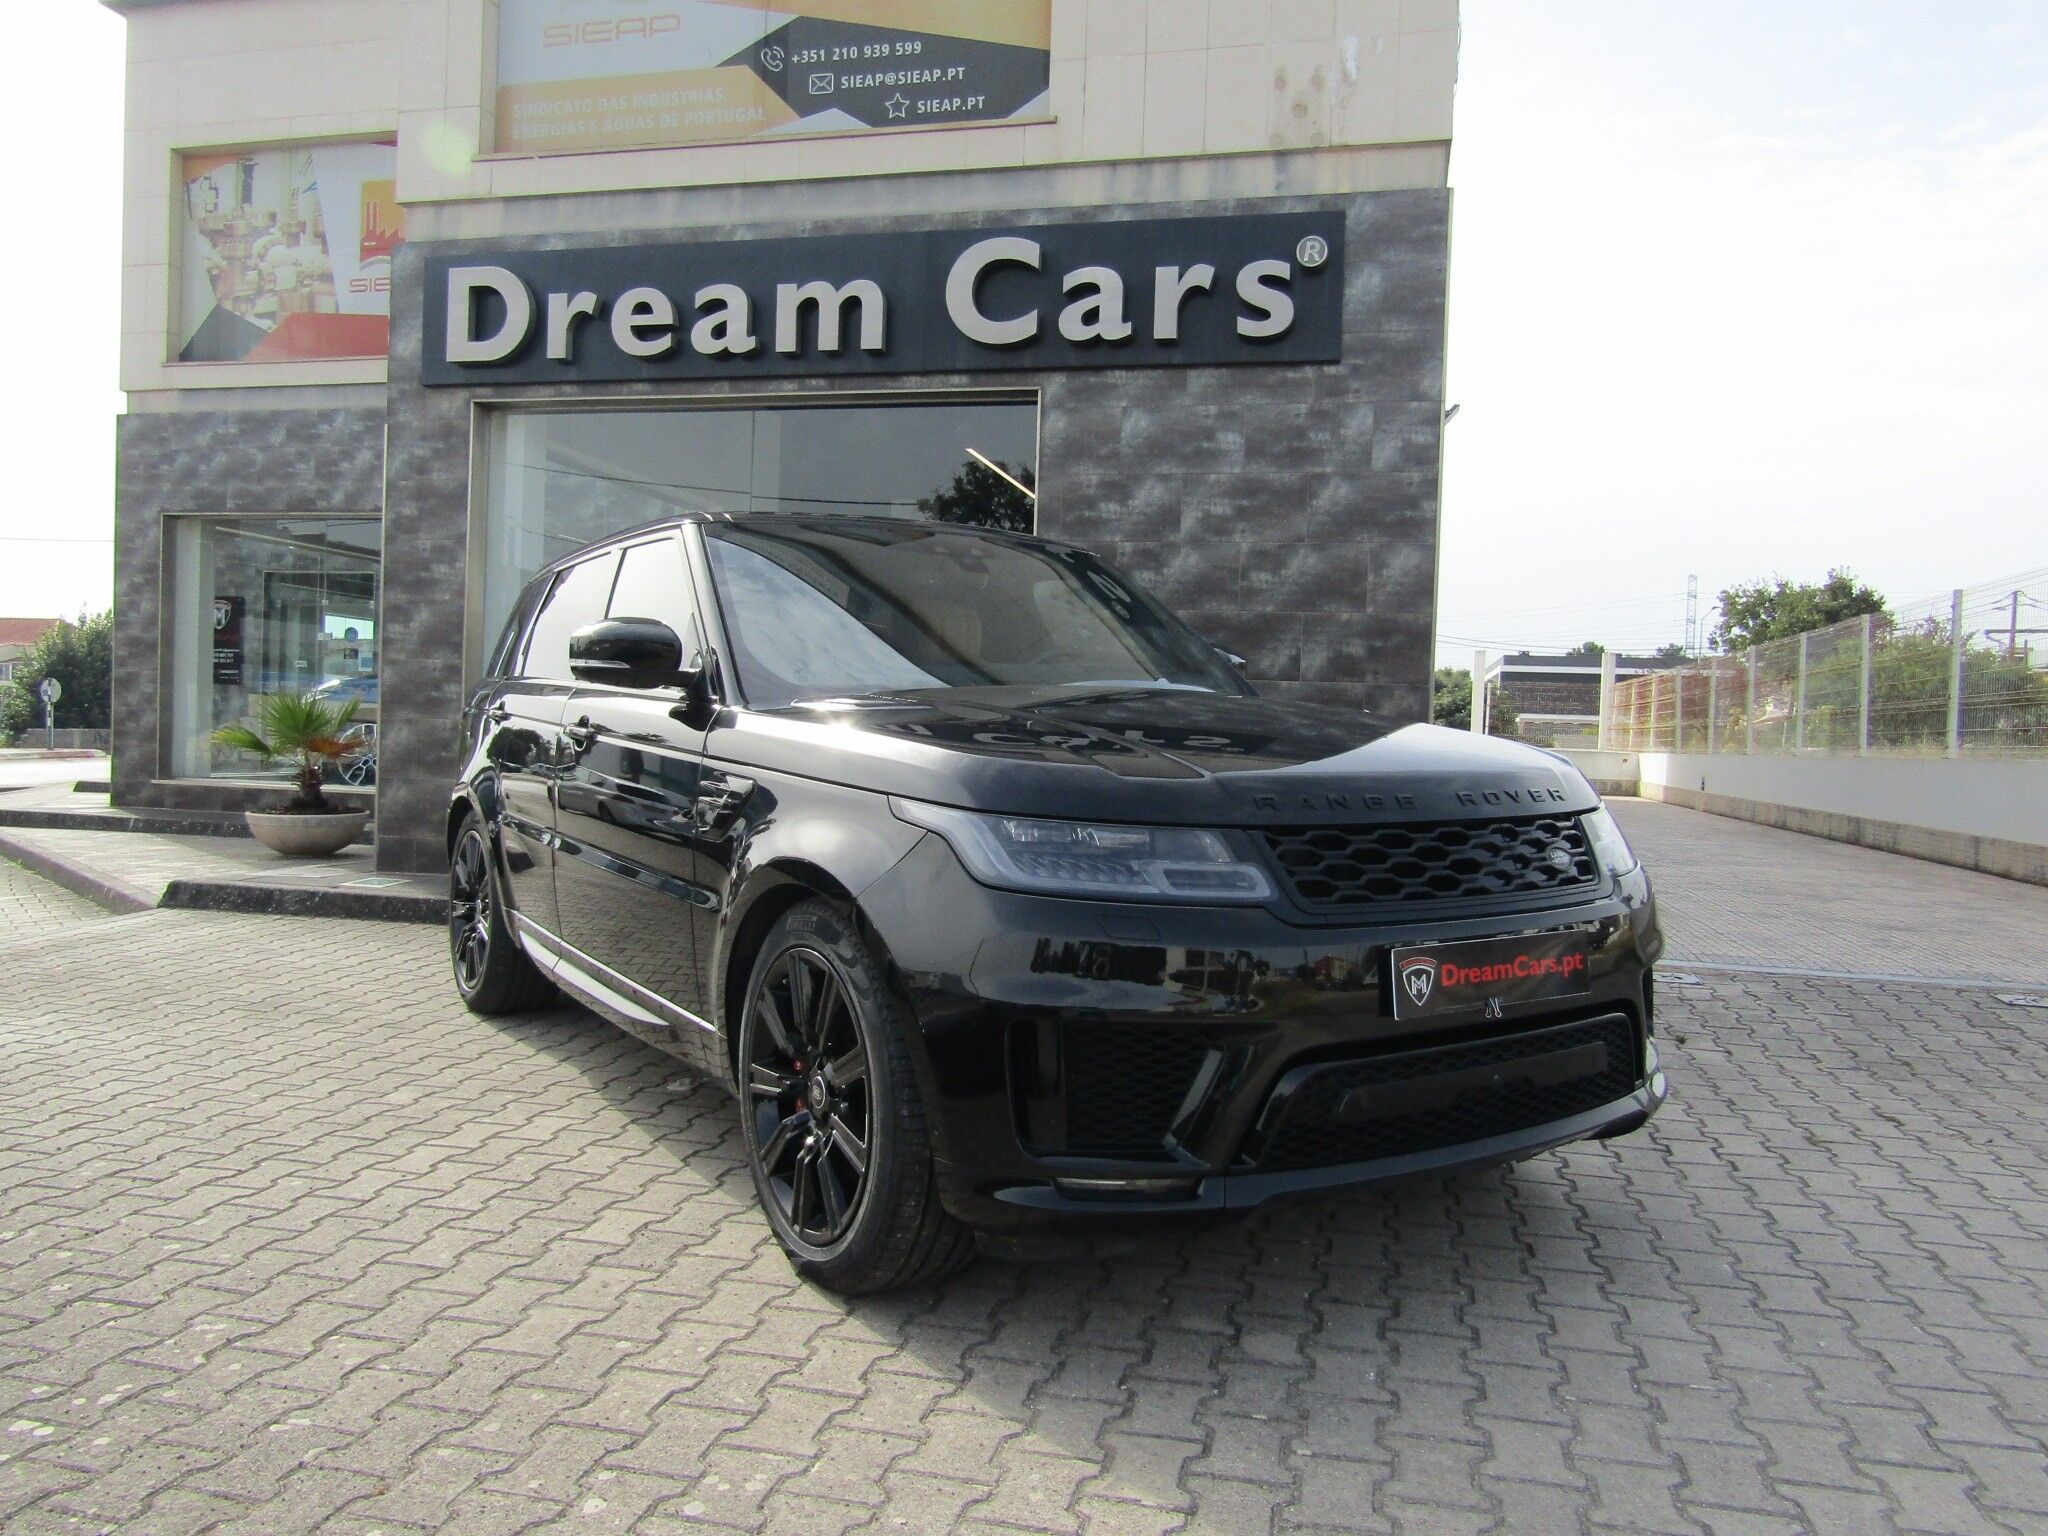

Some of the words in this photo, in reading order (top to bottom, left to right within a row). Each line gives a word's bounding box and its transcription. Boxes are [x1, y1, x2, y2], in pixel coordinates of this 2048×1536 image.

[543, 14, 681, 48] SIEAP
[791, 49, 826, 64] +351
[832, 47, 858, 61] 210
[864, 44, 890, 58] 939
[895, 41, 922, 56] 599
[841, 67, 966, 90] SIEAP@SIEAP.PT
[598, 96, 628, 111] DAS
[917, 96, 985, 114] SIEAP.PT
[512, 120, 585, 139] ENERGIAS
[590, 119, 599, 135] E
[659, 112, 679, 129] DE
[684, 107, 764, 126] PORTUGAL
[446, 264, 887, 364] Dream
[944, 236, 1294, 346] Cars
[1253, 793, 1418, 811] RANGE
[1454, 788, 1566, 807] ROVER
[1440, 951, 1584, 987] DreamCars.pt
